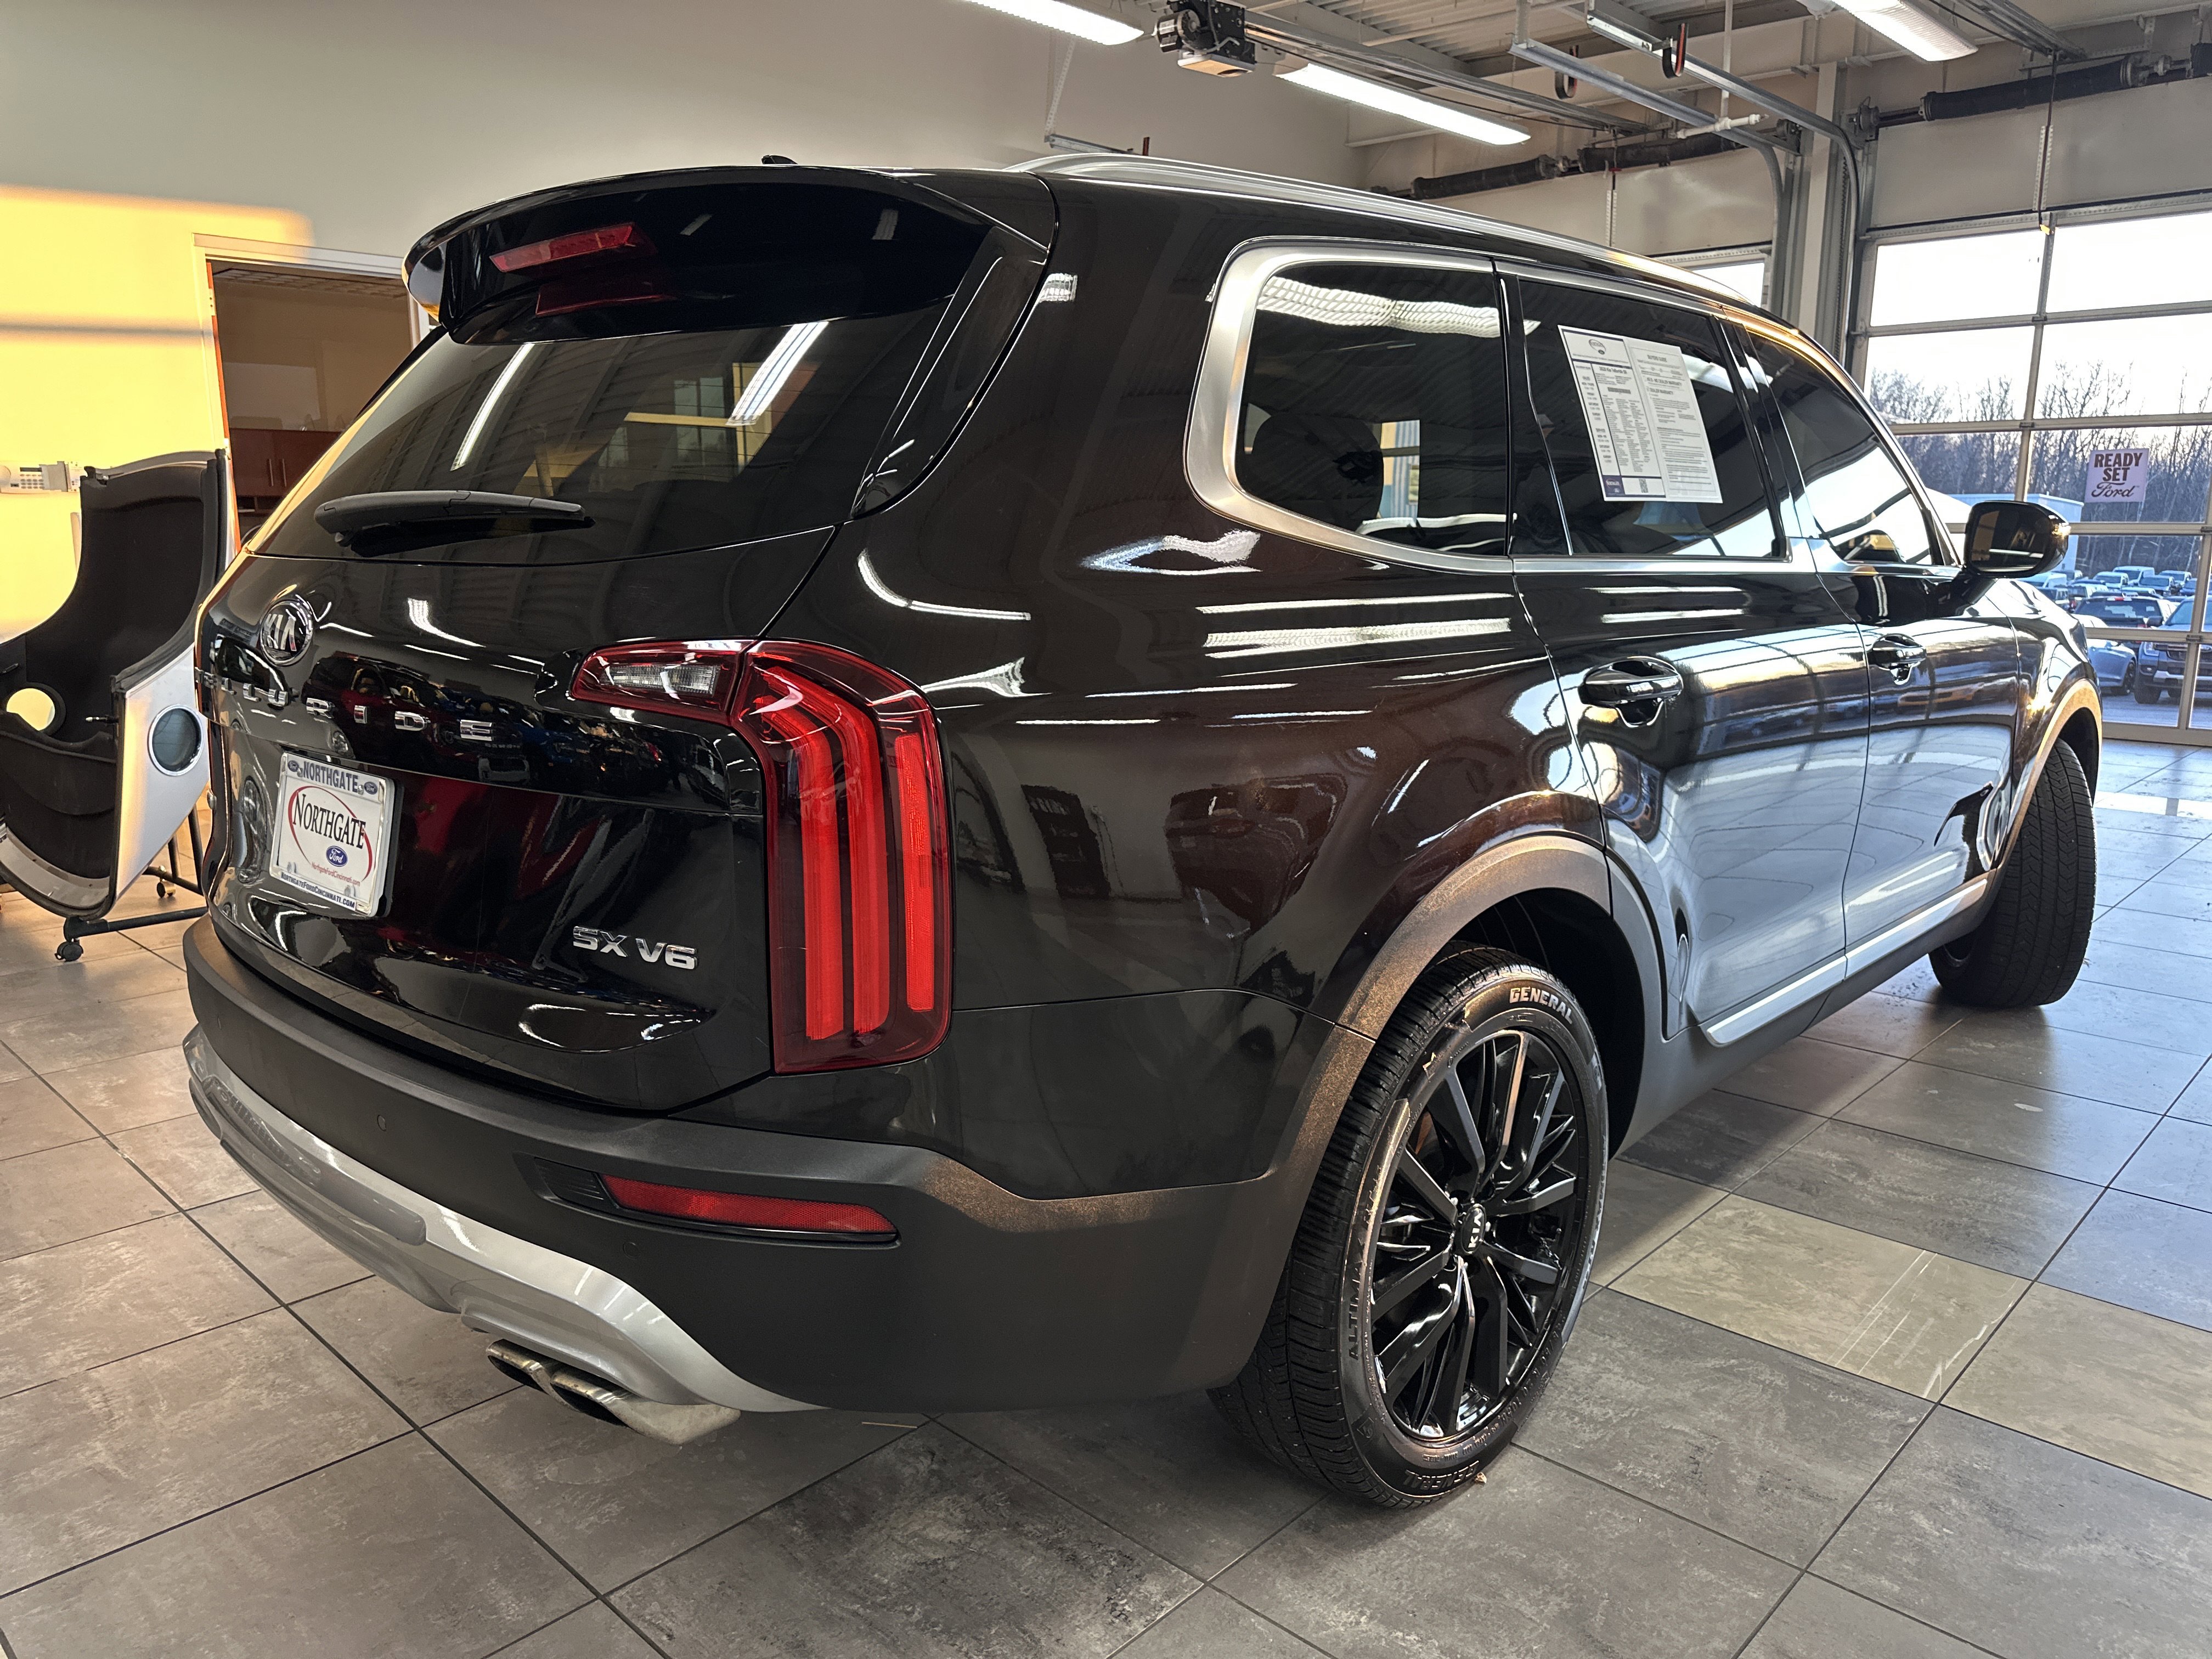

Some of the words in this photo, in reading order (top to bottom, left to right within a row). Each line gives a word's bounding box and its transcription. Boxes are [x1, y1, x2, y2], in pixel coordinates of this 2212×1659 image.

[2094, 453, 2143, 467] READY
[2102, 467, 2130, 481] SET
[2091, 482, 2140, 497] Ford
[303, 761, 359, 793] NORTHGATE
[292, 792, 366, 849] NORTHGATE
[329, 848, 344, 864] Ford
[573, 926, 629, 957] SX
[635, 938, 698, 970] V6
[1509, 986, 1573, 1025] GENERAL
[1468, 1212, 1482, 1248] KIA
[1404, 1460, 1480, 1491] GENERAL
